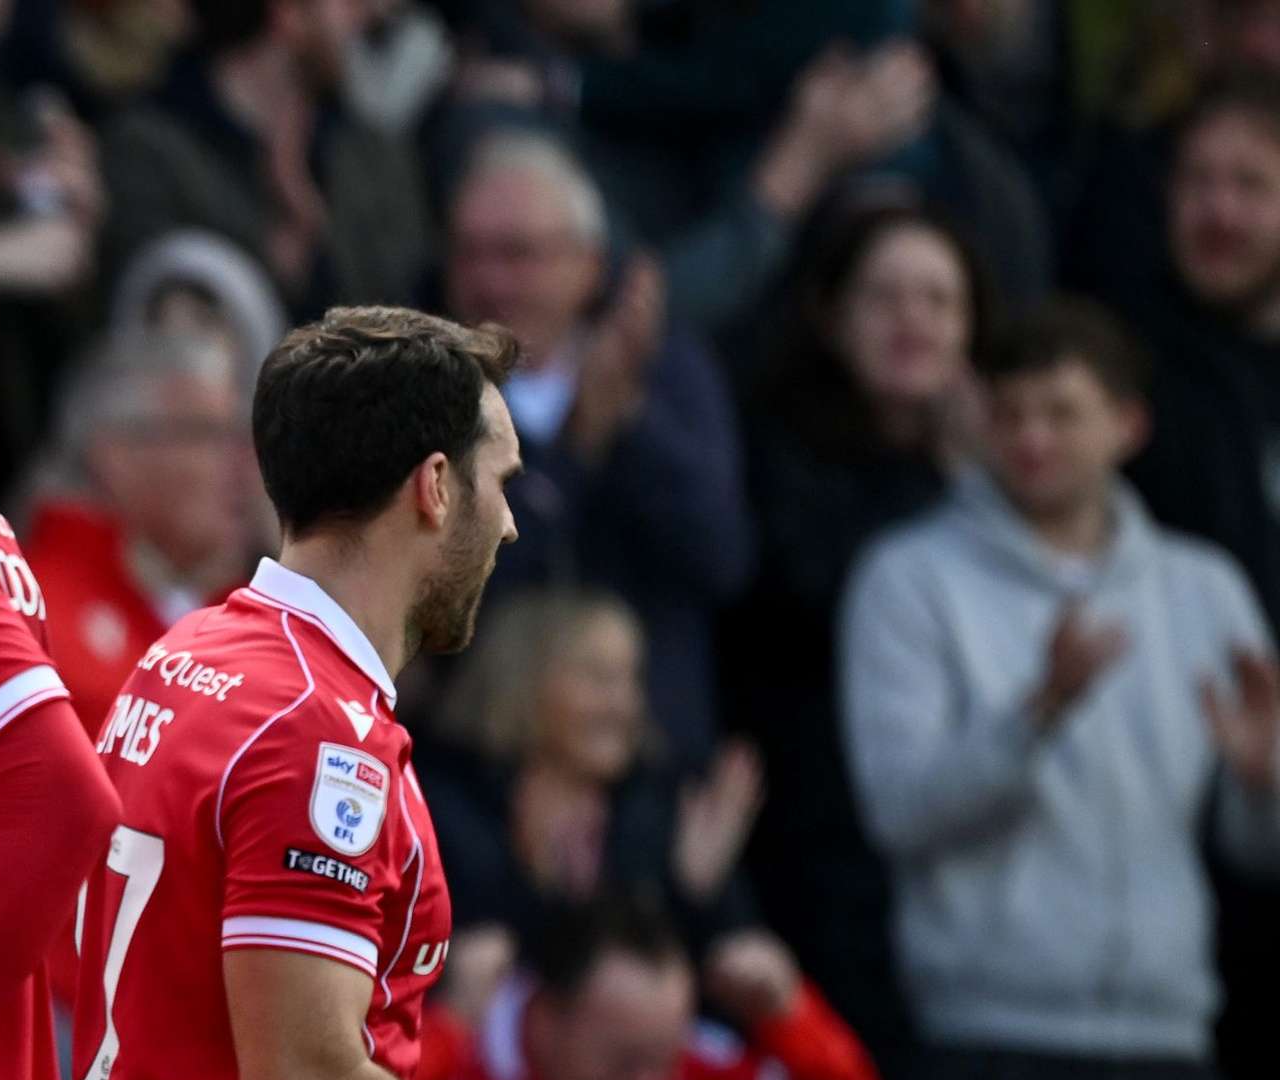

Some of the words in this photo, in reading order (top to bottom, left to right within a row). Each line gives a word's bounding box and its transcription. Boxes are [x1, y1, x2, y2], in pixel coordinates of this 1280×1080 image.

[159, 651, 245, 701] Quest
[96, 694, 175, 767] MES
[327, 757, 355, 774] sky
[334, 827, 354, 844] EFL
